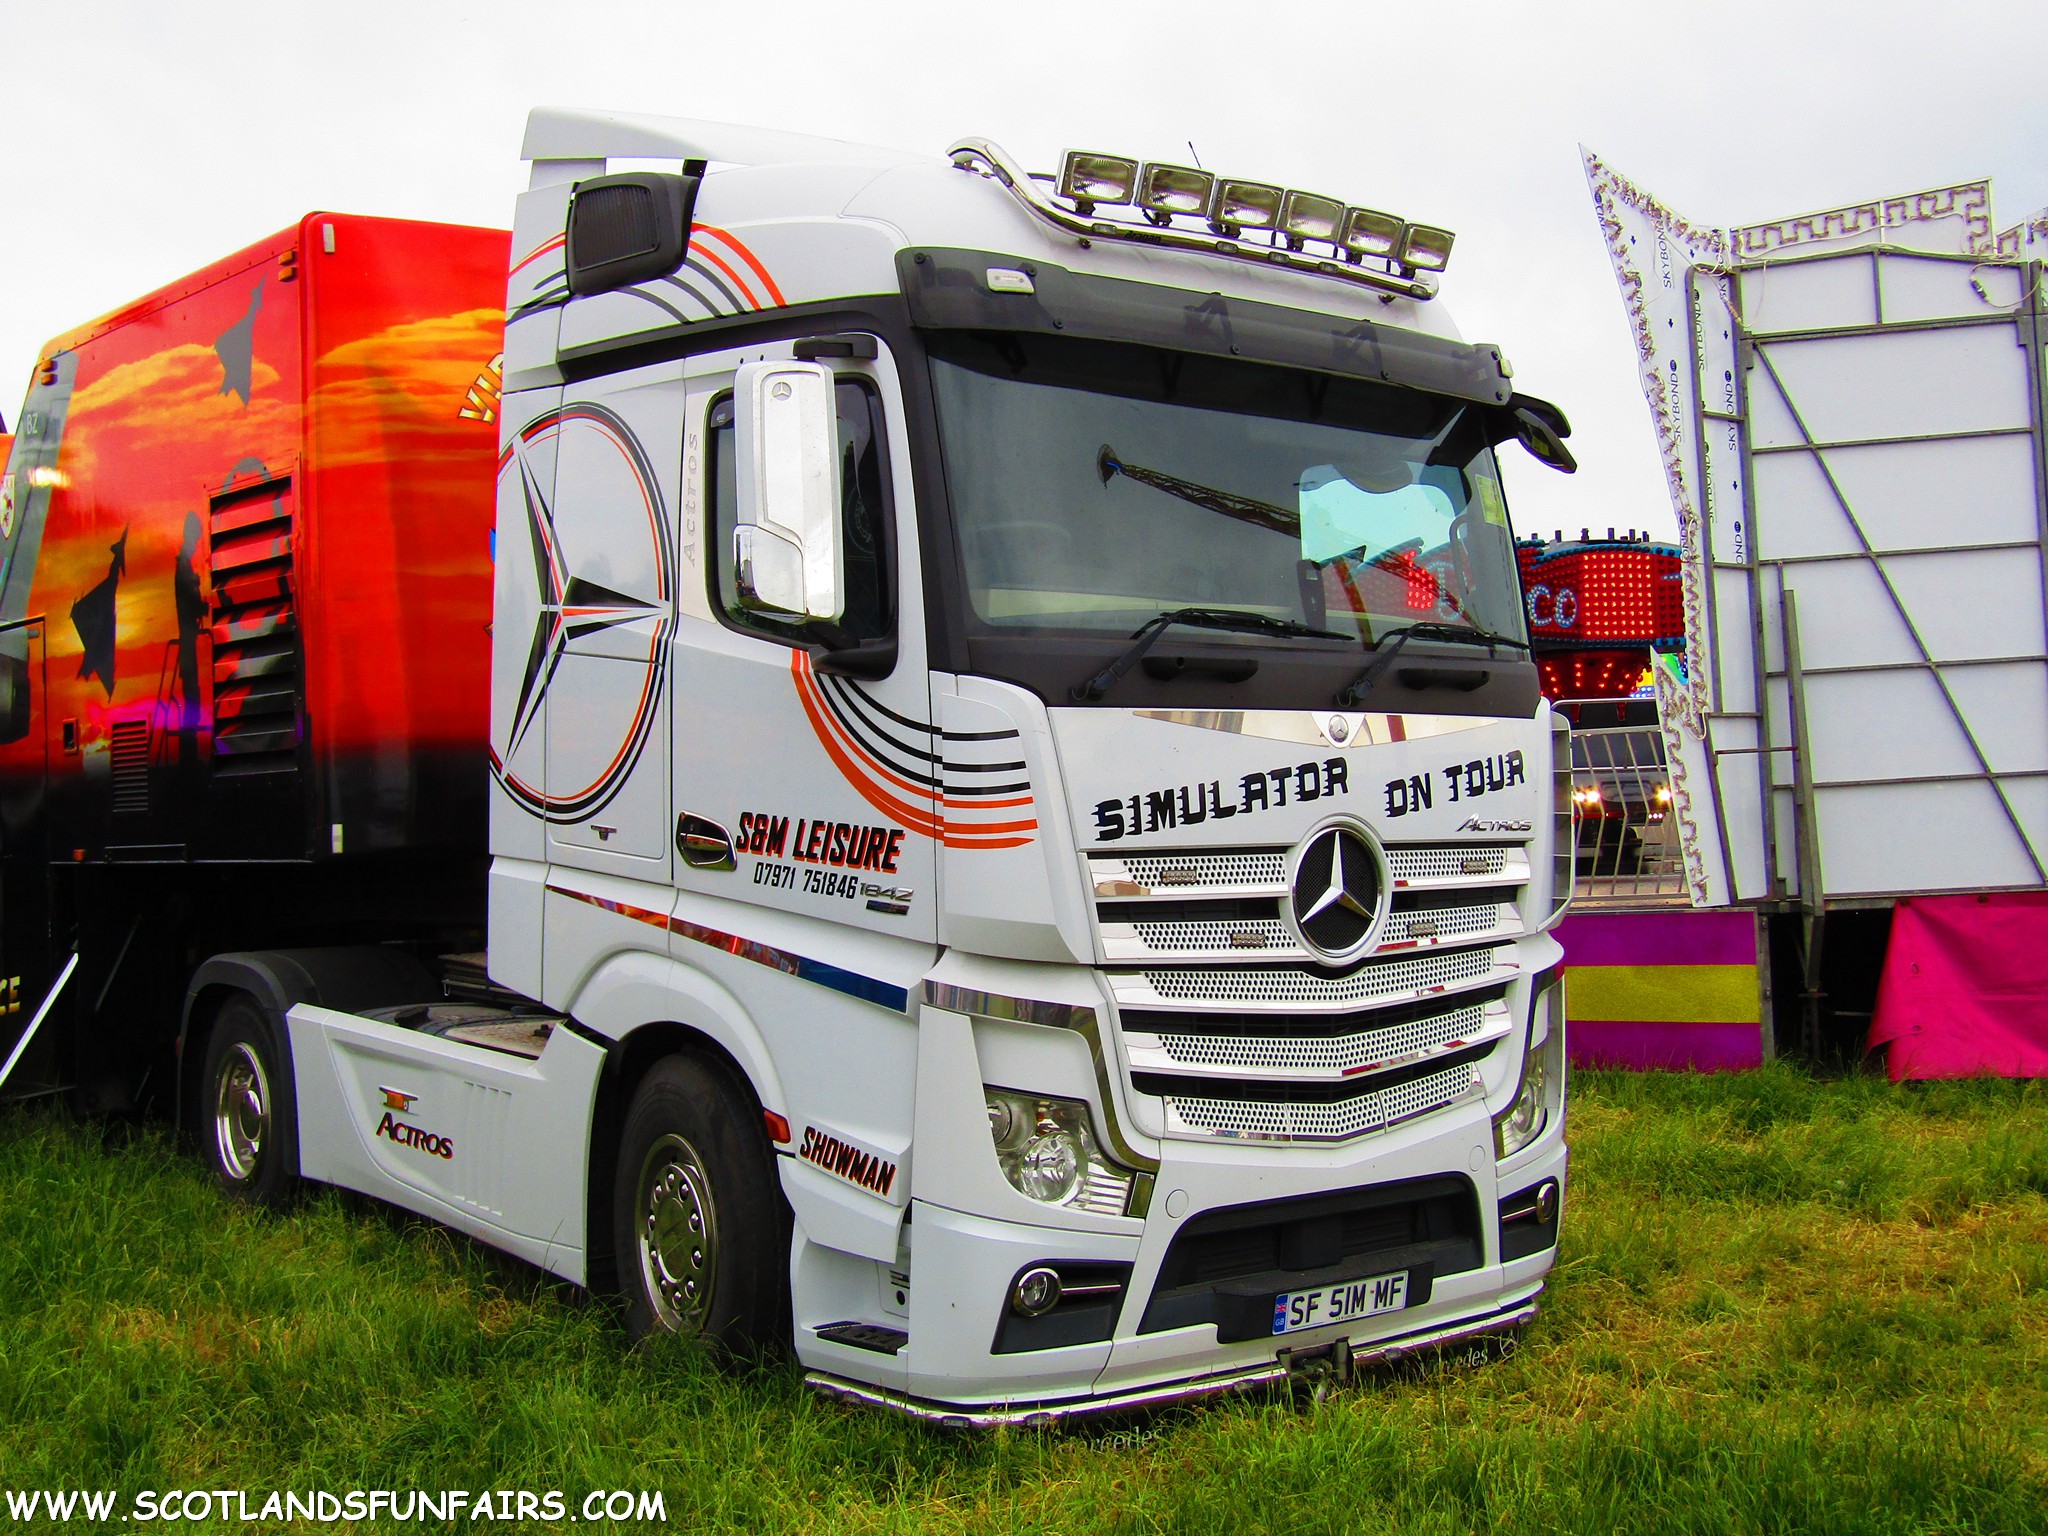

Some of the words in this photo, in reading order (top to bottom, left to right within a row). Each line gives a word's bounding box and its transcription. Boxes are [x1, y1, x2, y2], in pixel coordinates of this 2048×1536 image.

[1669, 373, 1682, 442] SKYBOND
[1726, 383, 1737, 451] SKYOND
[1091, 757, 1348, 841] SIMULATOR
[1384, 773, 1432, 817] ON
[1442, 750, 1525, 802] TOUR
[736, 811, 789, 858] S&M
[792, 818, 905, 875] LEISURE
[753, 862, 796, 890] 07971
[803, 870, 858, 899] 751846
[860, 882, 914, 902] 1842
[800, 1126, 896, 1197] SHOWMAN
[1275, 1318, 1285, 1327] GB
[1290, 1292, 1322, 1326] SF
[1374, 1276, 1404, 1309] MF
